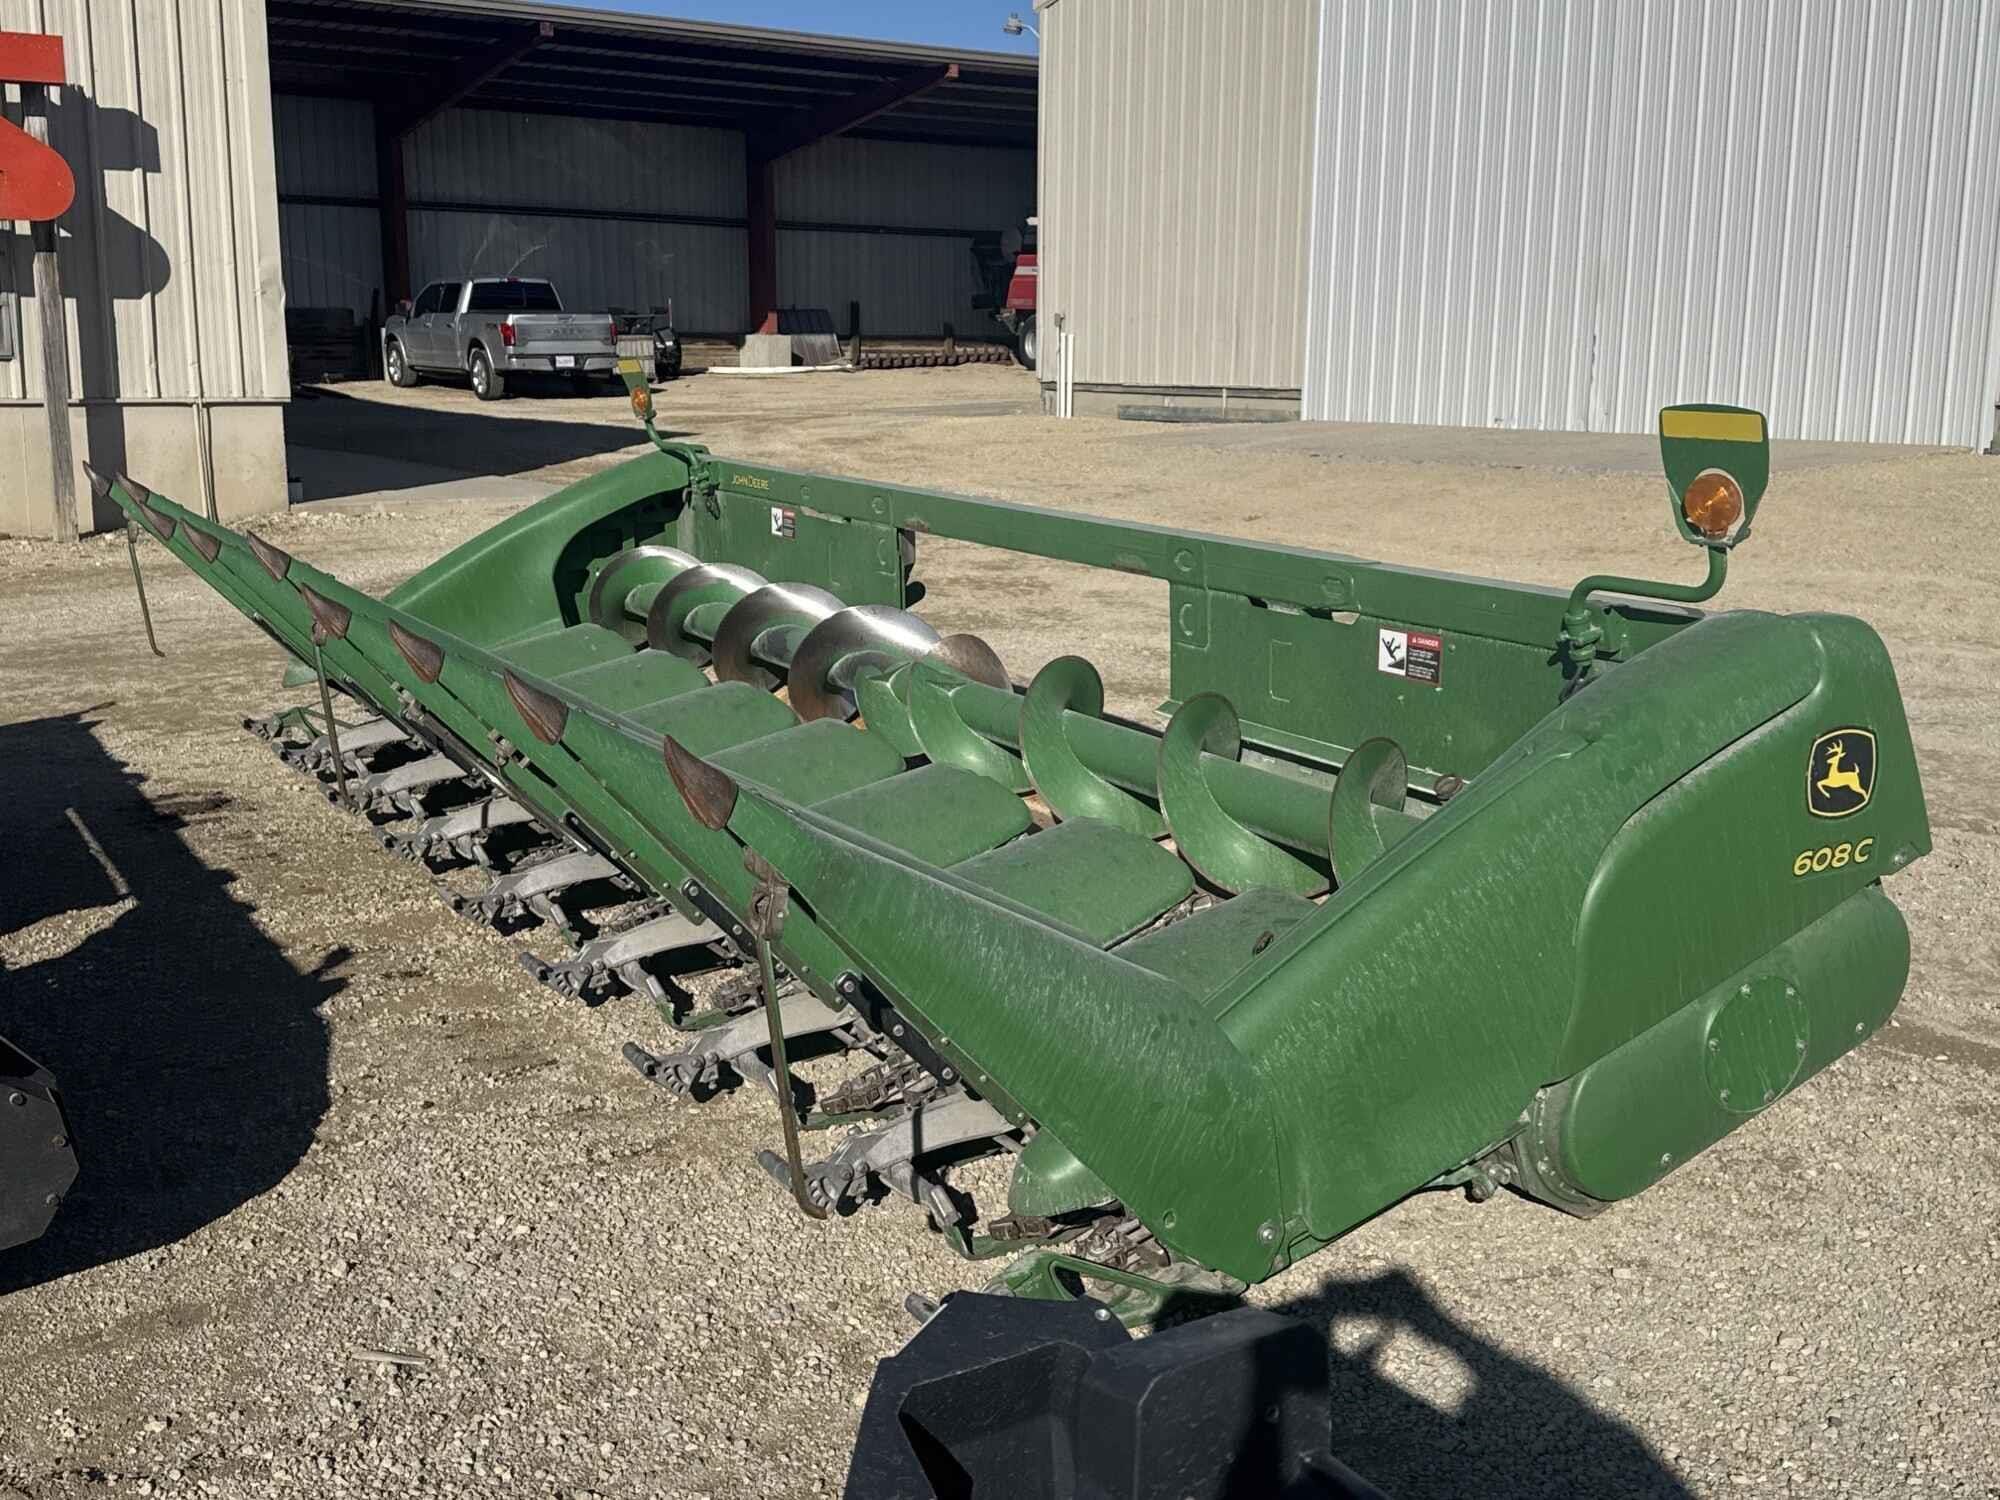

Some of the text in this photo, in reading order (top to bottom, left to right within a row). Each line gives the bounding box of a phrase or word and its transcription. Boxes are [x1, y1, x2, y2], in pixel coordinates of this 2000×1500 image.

[732, 474, 769, 490] JOHN DEERE
[1417, 637, 1439, 648] DANGER
[1793, 837, 1873, 876] 608C
